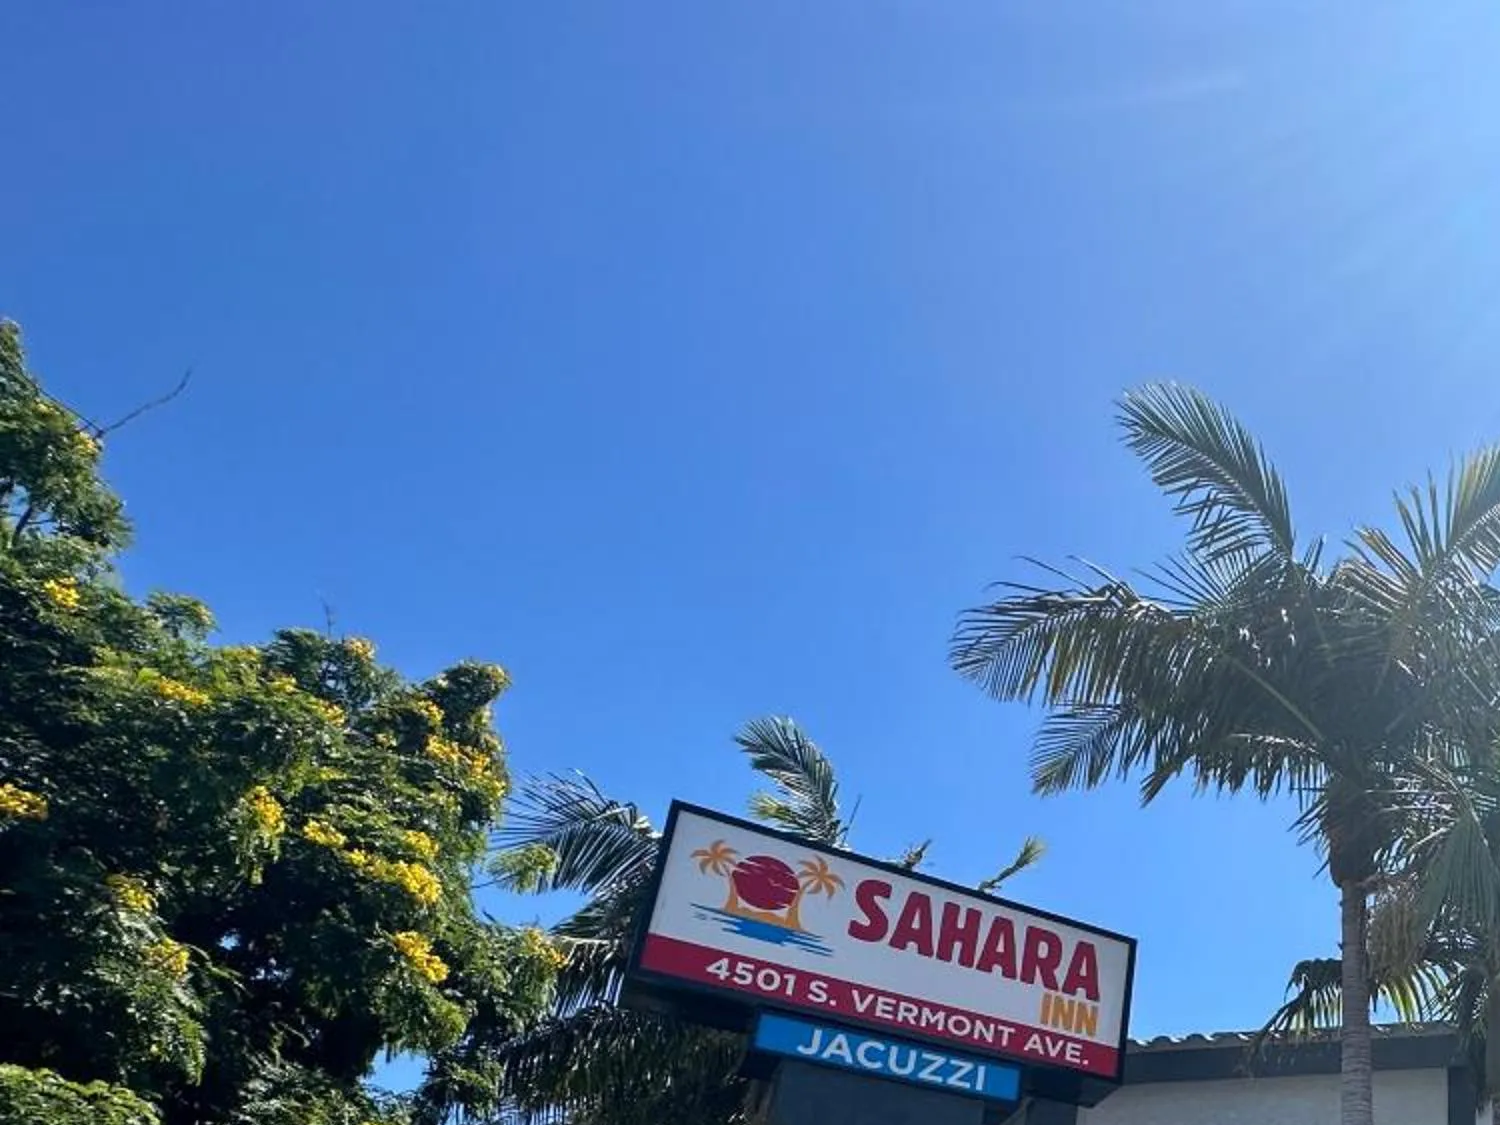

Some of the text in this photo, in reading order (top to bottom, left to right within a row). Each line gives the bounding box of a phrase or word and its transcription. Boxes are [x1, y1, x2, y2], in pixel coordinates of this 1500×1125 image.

[848, 879, 1100, 1001] SAHARA
[706, 957, 1090, 1065] 4501 S. VERMONT AVE.
[1039, 993, 1098, 1037] INN
[797, 1028, 986, 1091] JACUZZI
